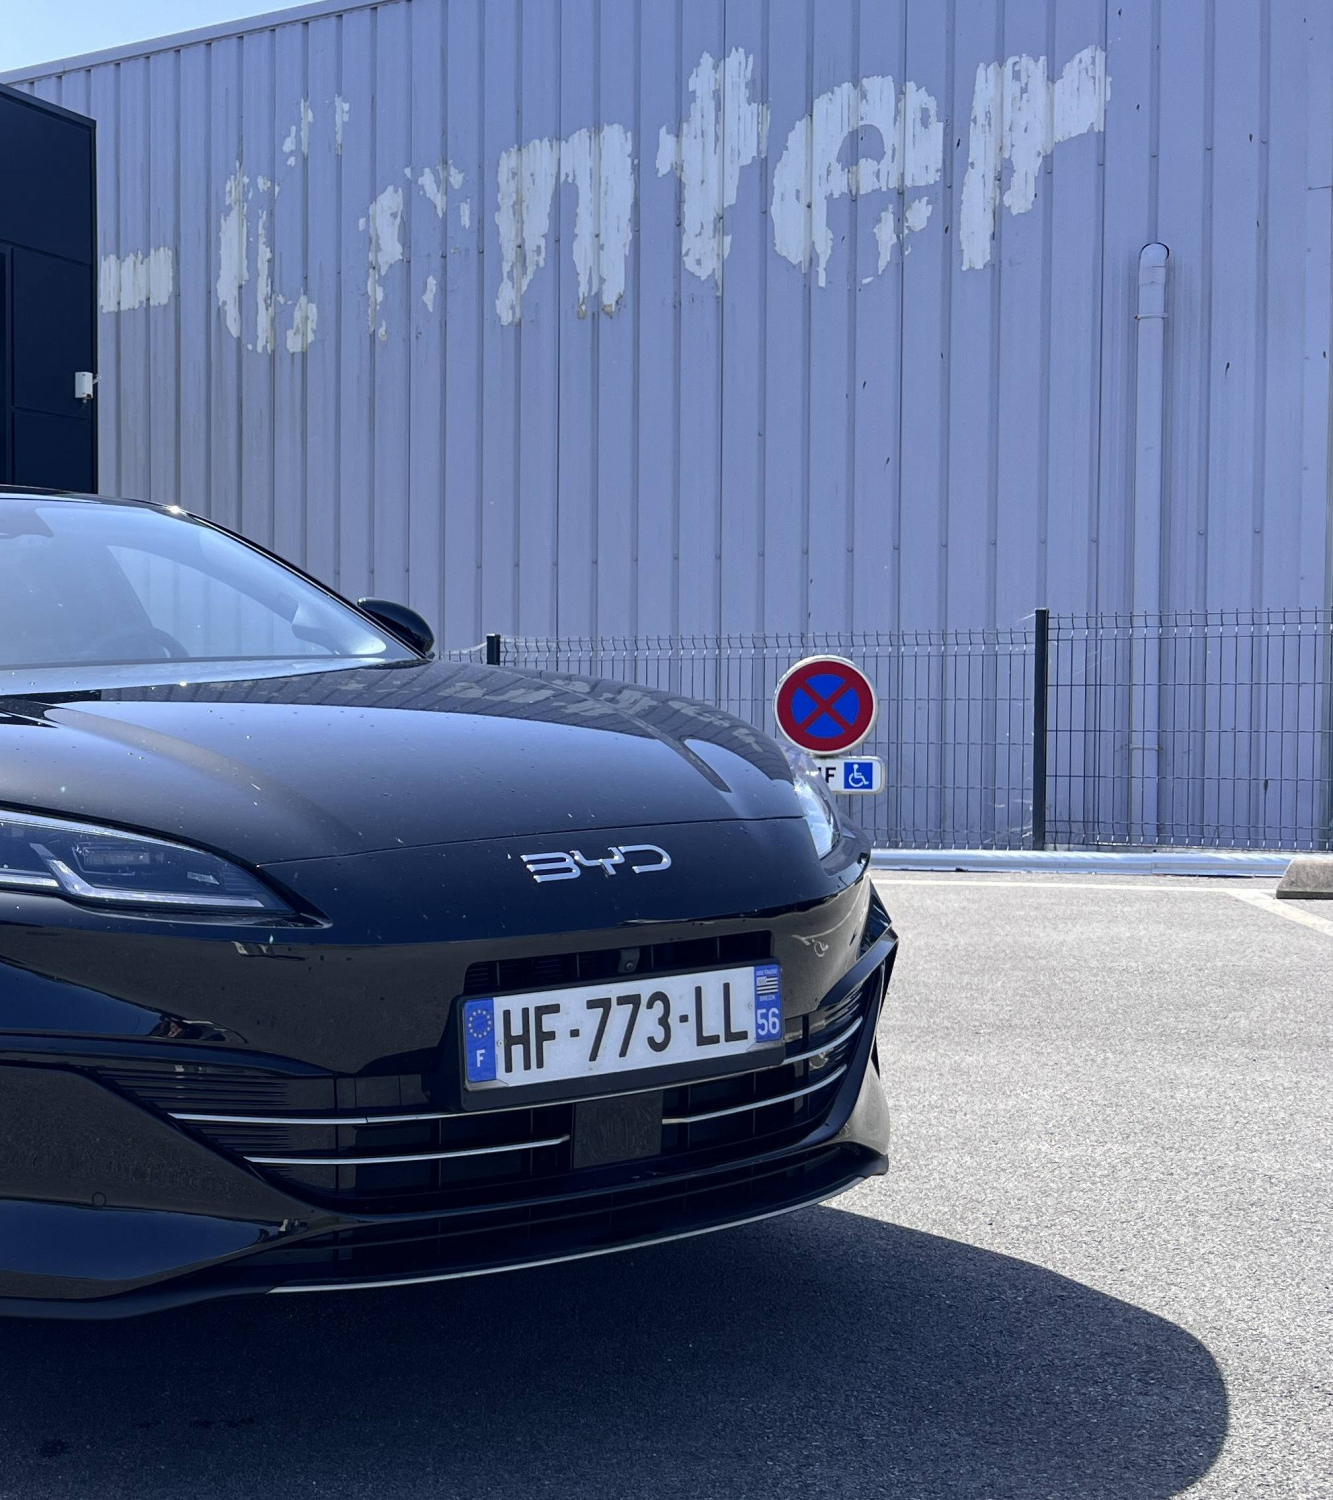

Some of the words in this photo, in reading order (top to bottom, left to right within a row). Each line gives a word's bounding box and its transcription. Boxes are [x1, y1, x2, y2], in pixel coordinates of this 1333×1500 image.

[520, 844, 672, 883] BYD
[502, 981, 749, 1074] HF-773-LL
[756, 1007, 780, 1036] 56
[475, 1048, 486, 1068] F
